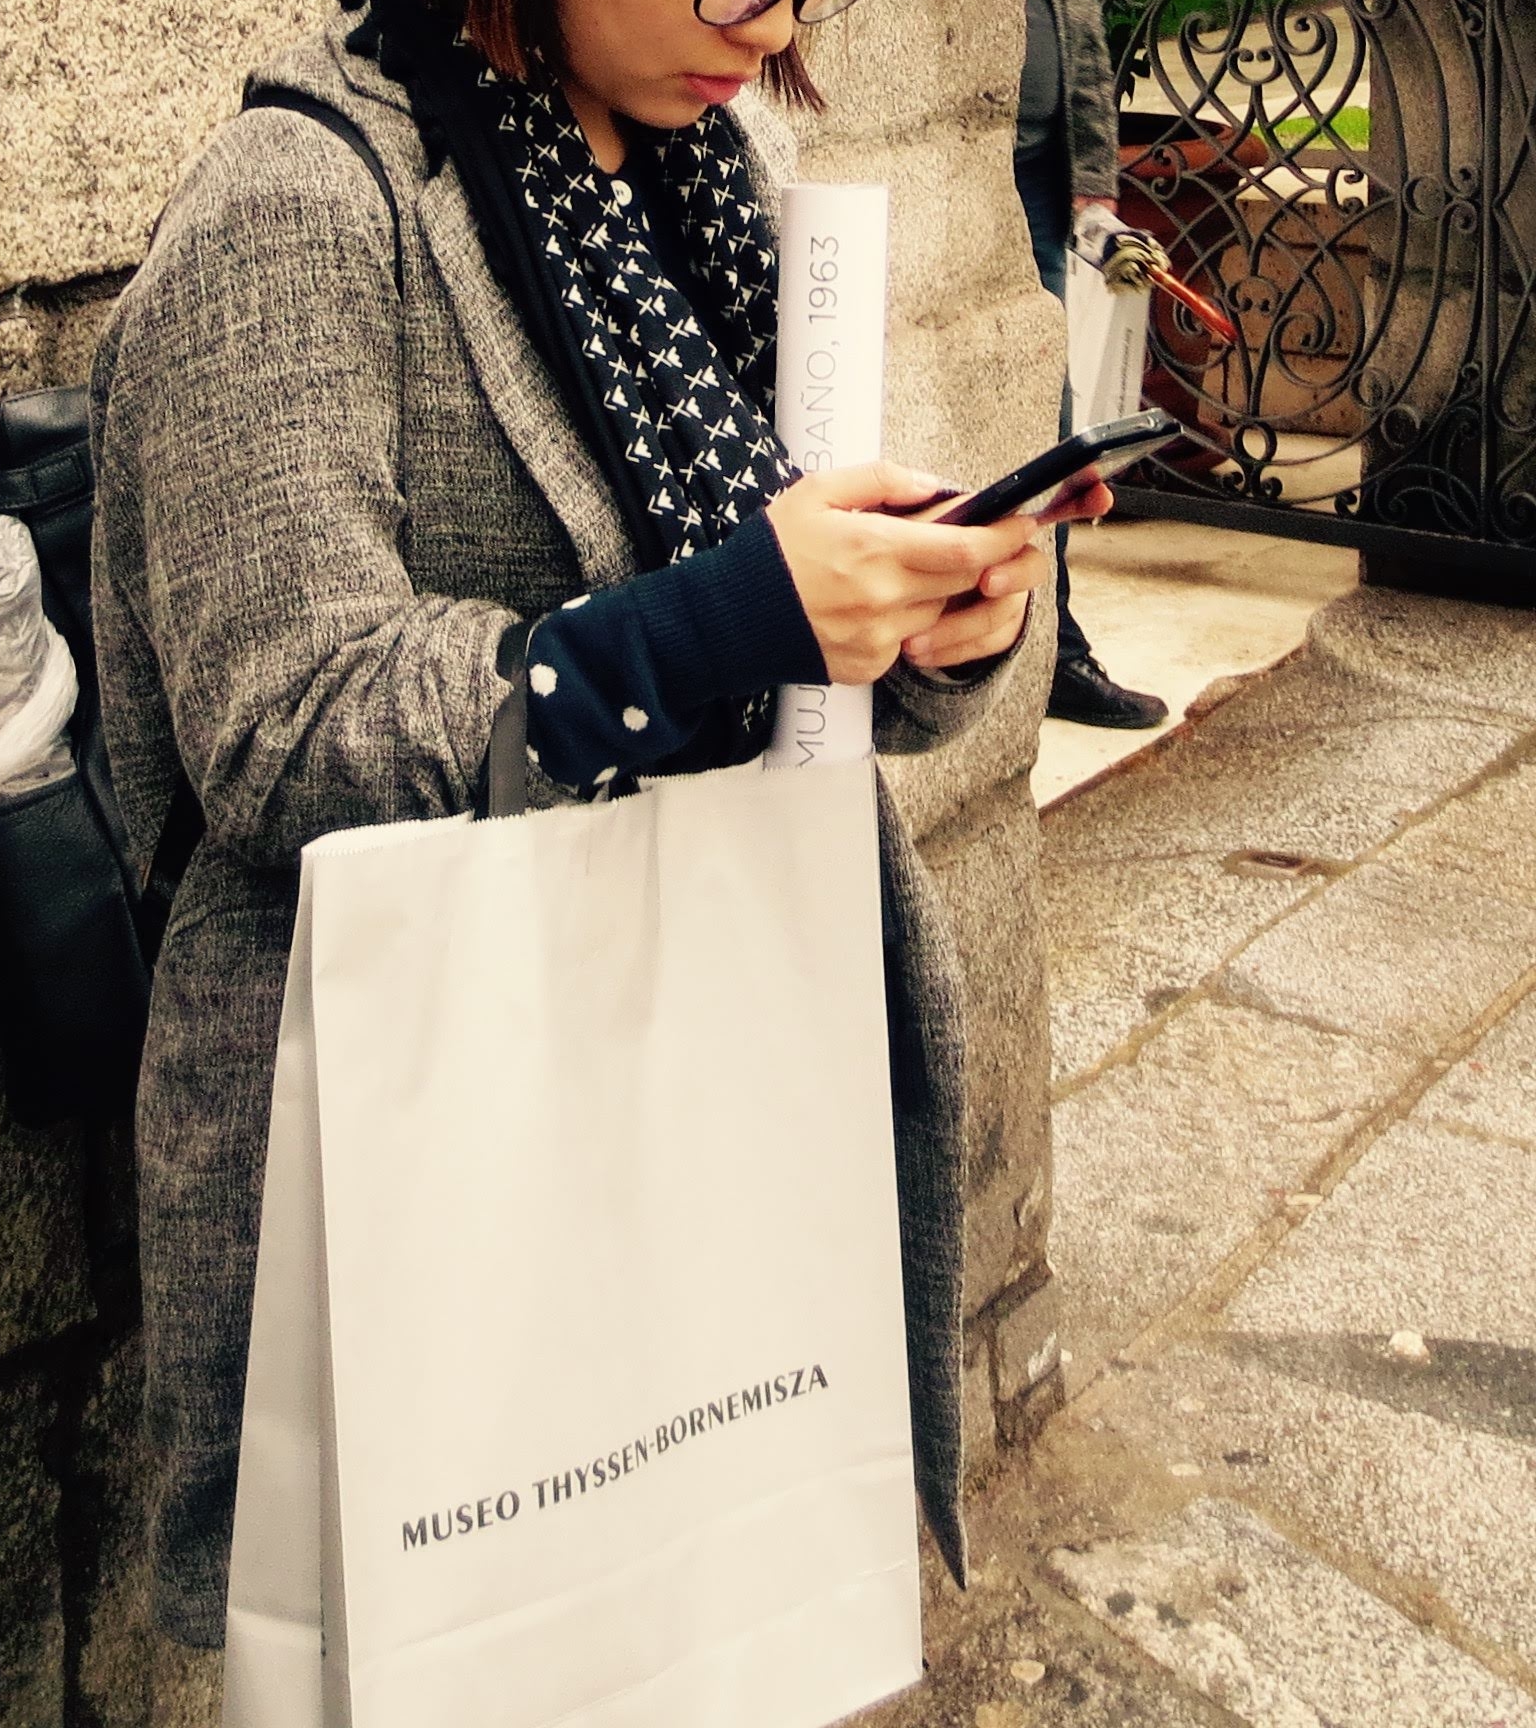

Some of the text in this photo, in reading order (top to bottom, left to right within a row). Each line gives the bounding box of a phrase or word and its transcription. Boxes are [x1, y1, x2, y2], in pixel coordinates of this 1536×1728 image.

[807, 234, 840, 326] 1963
[800, 338, 841, 474] BAÑO,
[401, 1363, 829, 1552] MUSEO THYSSEN-BORNEMISZA
